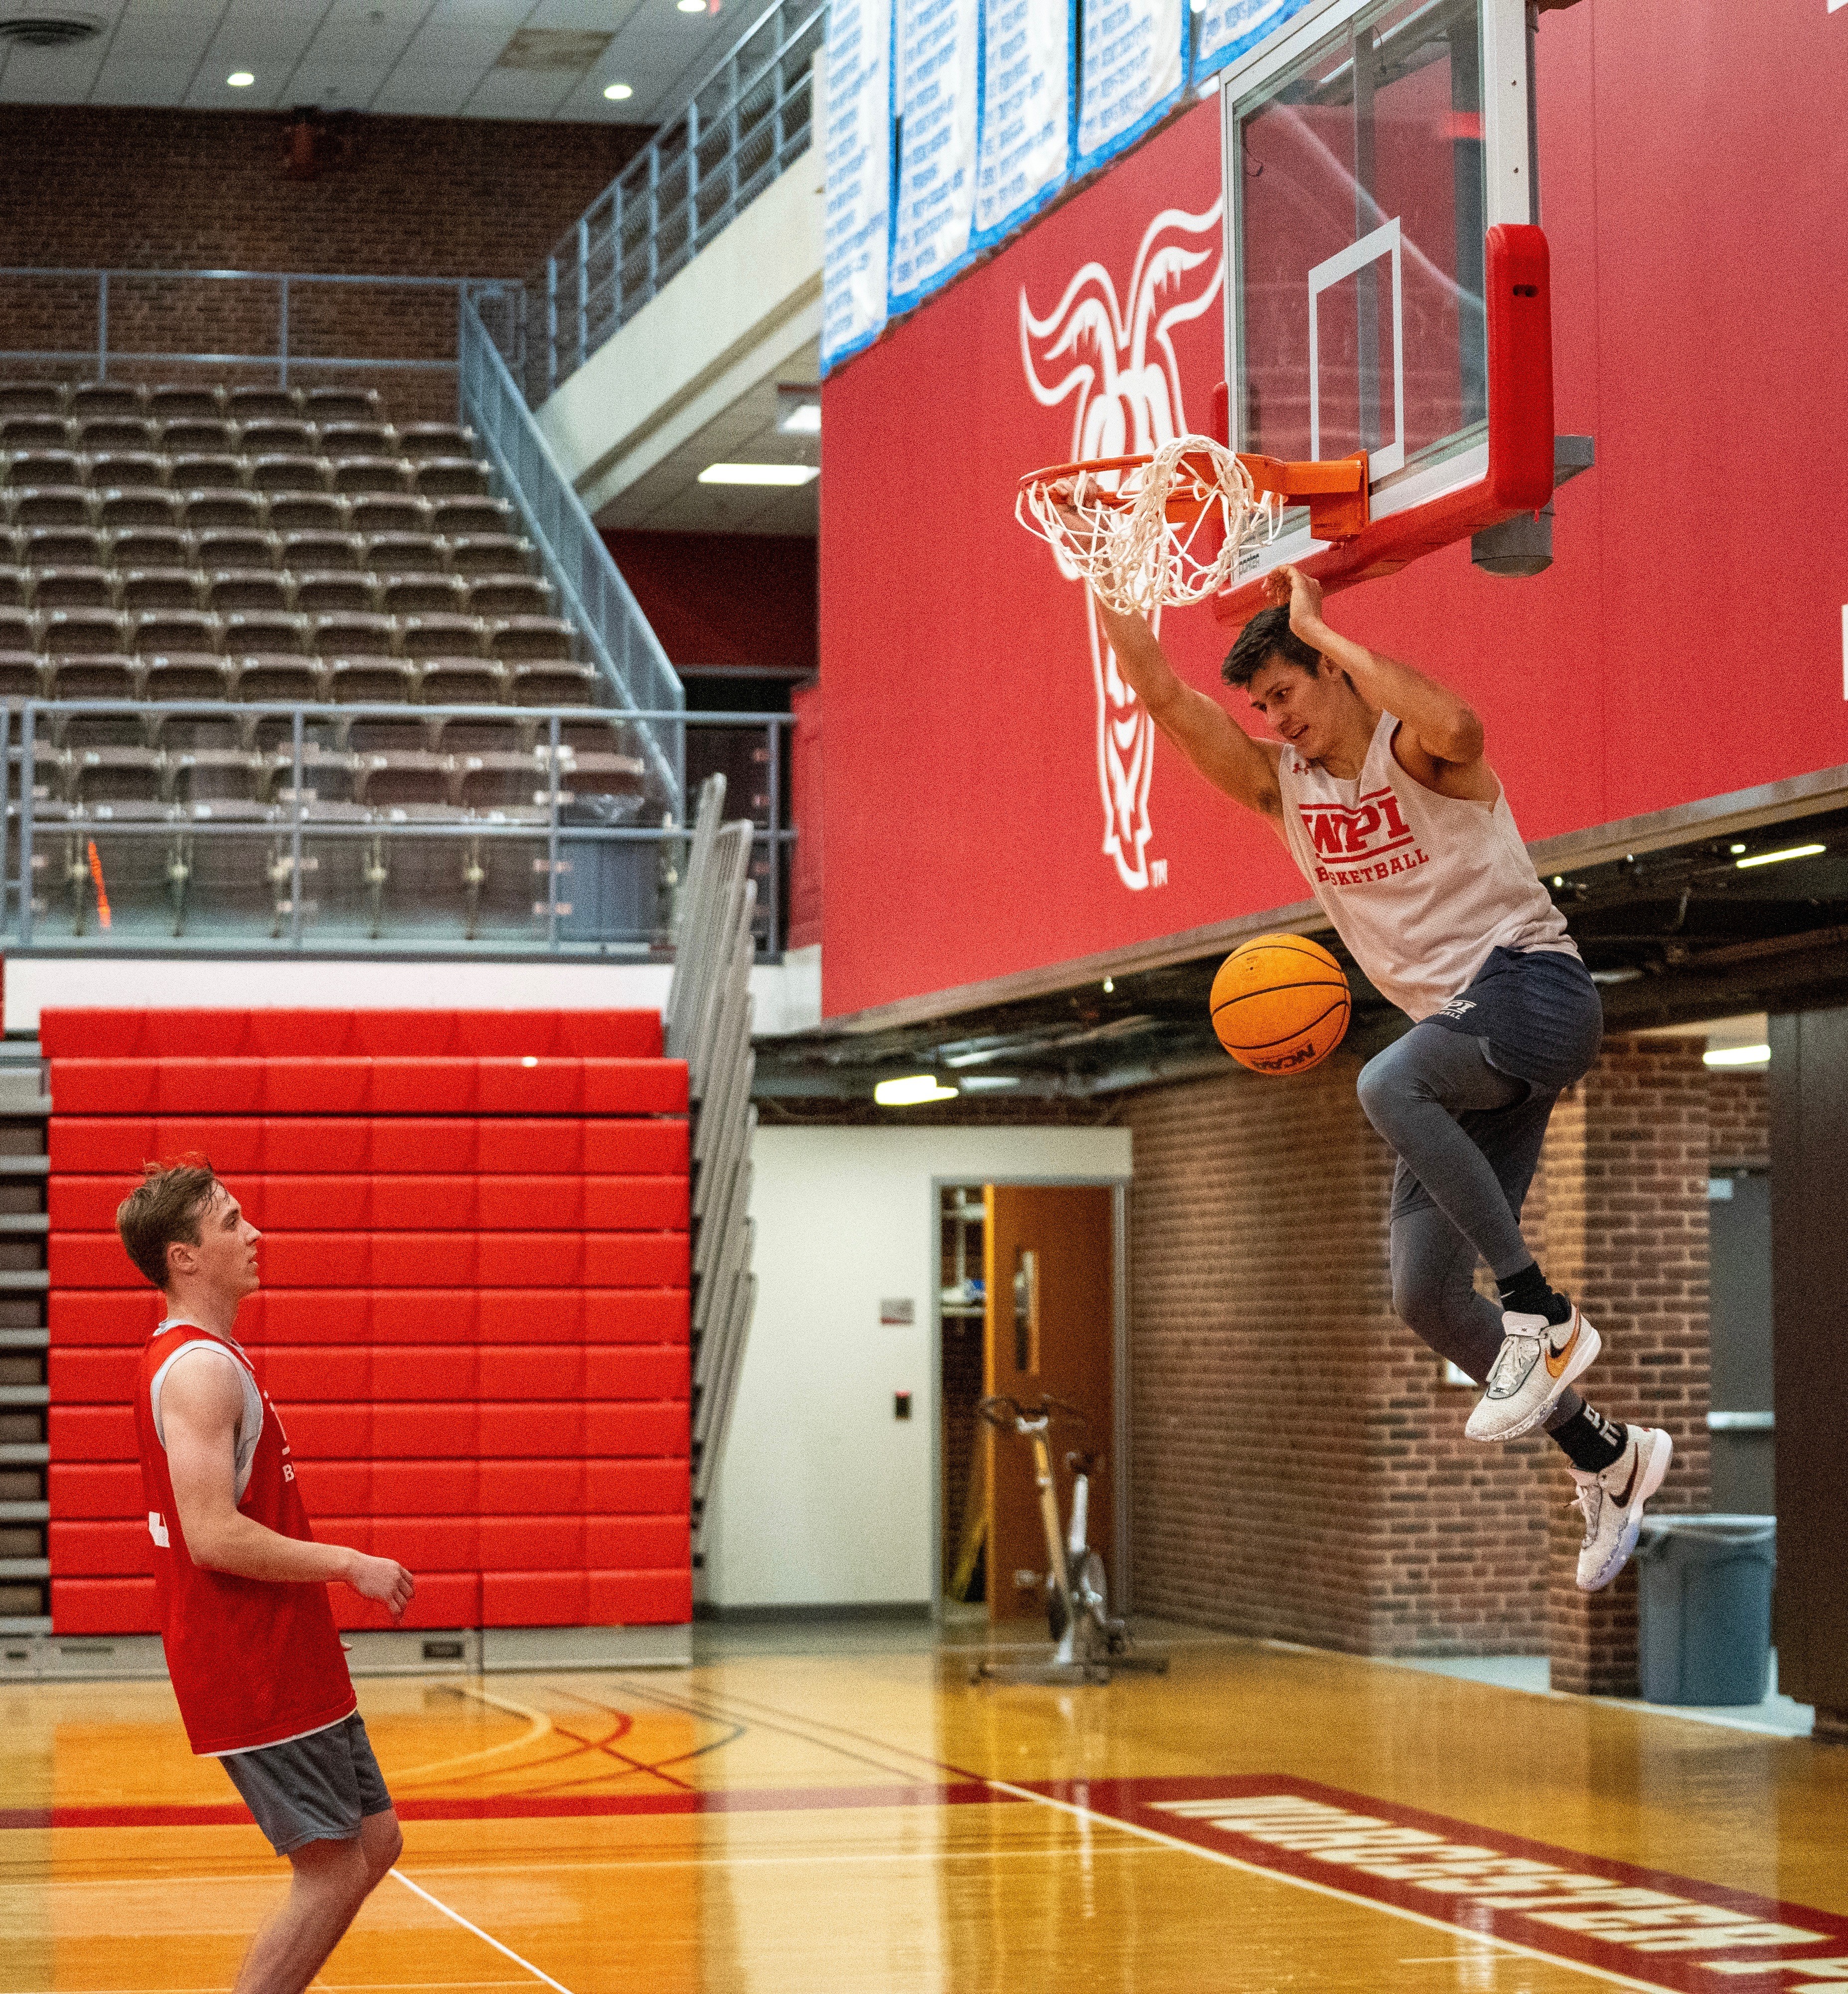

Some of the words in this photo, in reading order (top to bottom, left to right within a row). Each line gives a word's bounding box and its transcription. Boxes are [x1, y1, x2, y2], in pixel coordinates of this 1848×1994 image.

[1301, 796, 1410, 853] WPI
[1315, 848, 1429, 885] BSKETBALL
[1444, 1001, 1475, 1013] PI
[1148, 1795, 1835, 1952] WORCESTER
